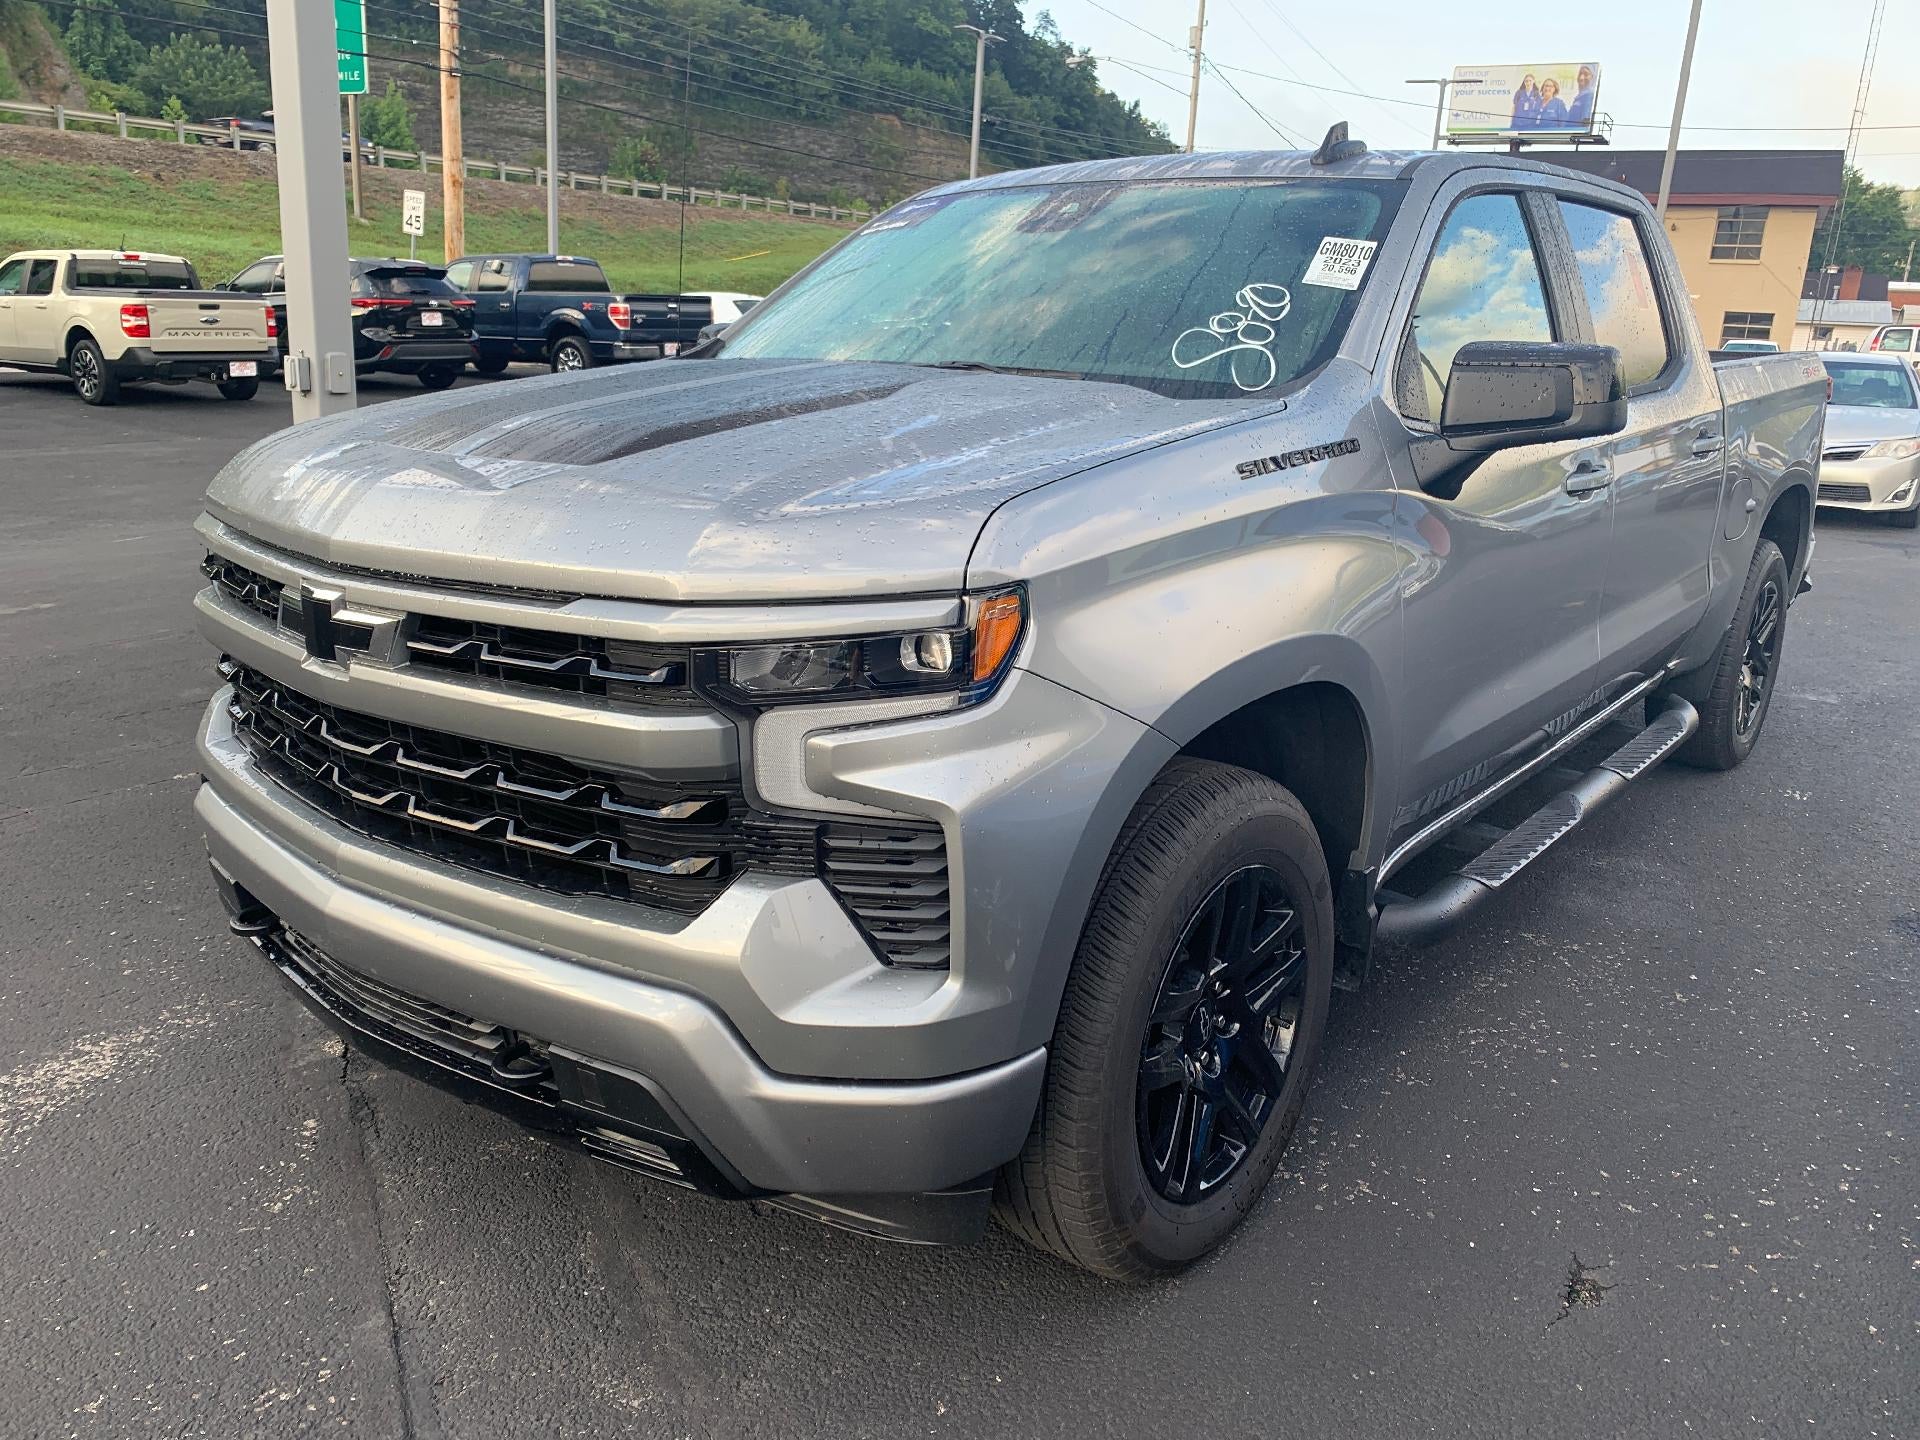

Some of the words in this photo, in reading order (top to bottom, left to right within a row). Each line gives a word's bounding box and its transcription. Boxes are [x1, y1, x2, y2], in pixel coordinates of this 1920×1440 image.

[1455, 89, 1474, 98] your
[405, 195, 423, 205] SPEED
[405, 214, 422, 231] 45
[1320, 241, 1374, 261] GM8010
[1323, 256, 1362, 268] 2023
[1235, 437, 1361, 480] SILVERADO
